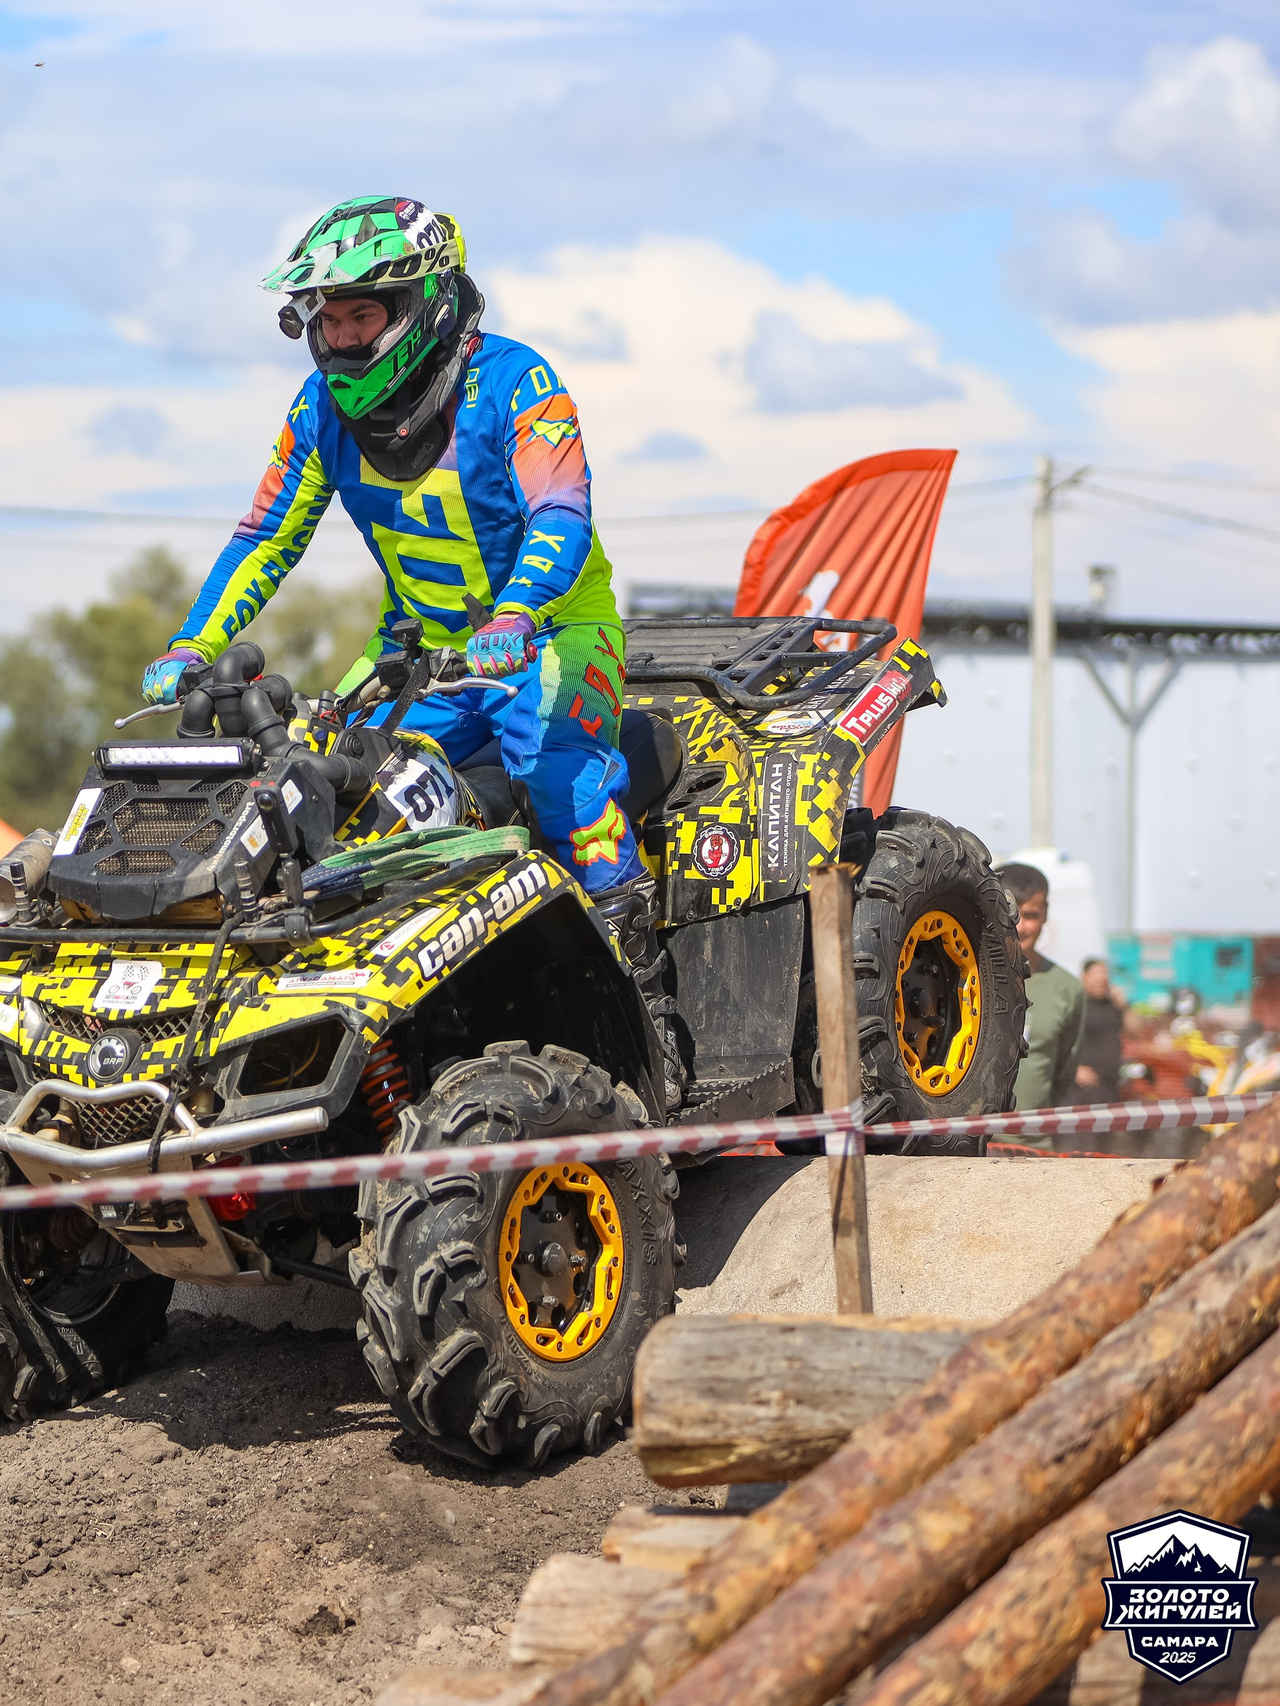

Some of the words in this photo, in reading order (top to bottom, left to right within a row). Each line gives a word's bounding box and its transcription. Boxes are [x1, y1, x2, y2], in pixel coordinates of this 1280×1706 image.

[221, 577, 269, 643] FOX
[403, 764, 455, 823] 071
[785, 762, 793, 787] ОТДЫХА
[767, 763, 784, 868] КАПИТАН
[417, 862, 547, 980] can-am
[102, 1057, 123, 1065] BRP
[614, 1157, 658, 1266] AXXIS
